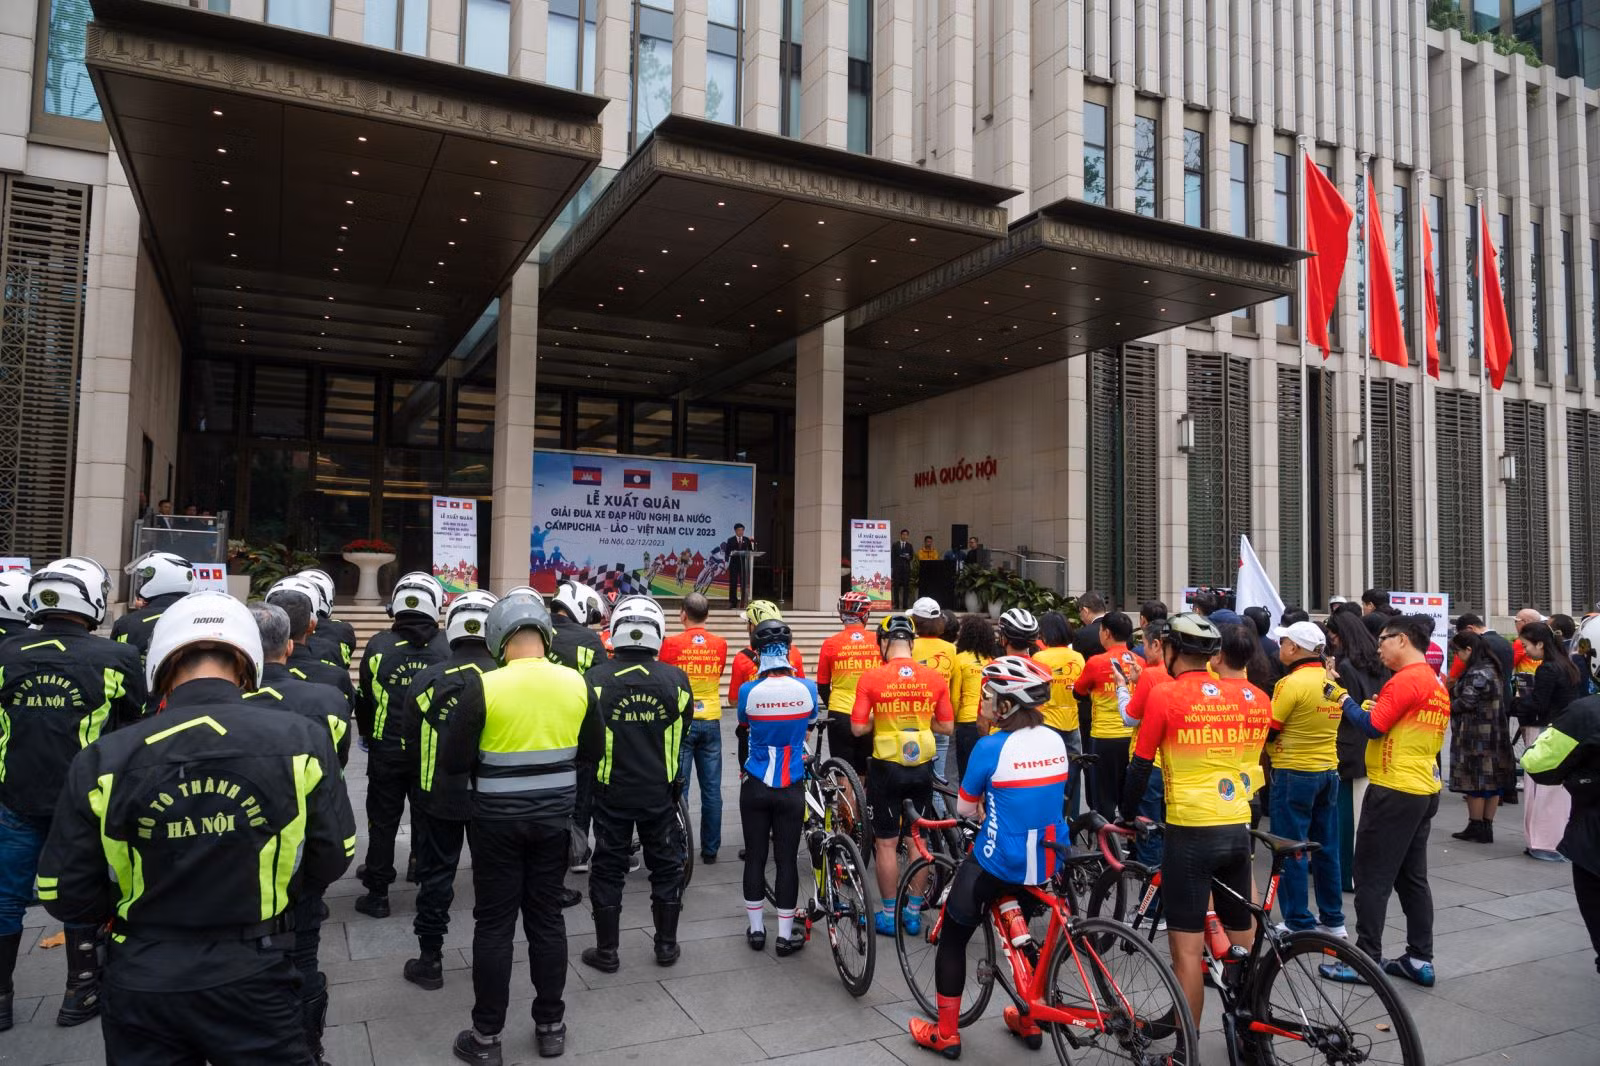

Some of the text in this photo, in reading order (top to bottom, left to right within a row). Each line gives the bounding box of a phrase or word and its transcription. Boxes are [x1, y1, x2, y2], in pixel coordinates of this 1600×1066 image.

[914, 455, 997, 488] NHÀ QUỐC HỘI
[586, 490, 680, 510] LỄ XUẤT QUÂN
[574, 508, 592, 518] ĐUA
[595, 510, 606, 519] XE
[608, 510, 626, 522] ĐẠP
[629, 511, 646, 520] HỮU
[649, 512, 670, 524] NGHỊ
[673, 514, 684, 522] BA
[687, 513, 712, 524] NƯỚC
[656, 526, 676, 536] NAM
[678, 526, 694, 536] CLV
[696, 528, 716, 537] 2023
[626, 538, 664, 546] 02/12/2023
[26, 694, 66, 708] HÀ NỘI
[624, 710, 655, 723] HÀ NỘI
[1177, 724, 1223, 744] MIỀN
[1013, 756, 1066, 770] MIMECO
[178, 776, 240, 800] THÀNH
[166, 812, 236, 838] HÀ NỘI
